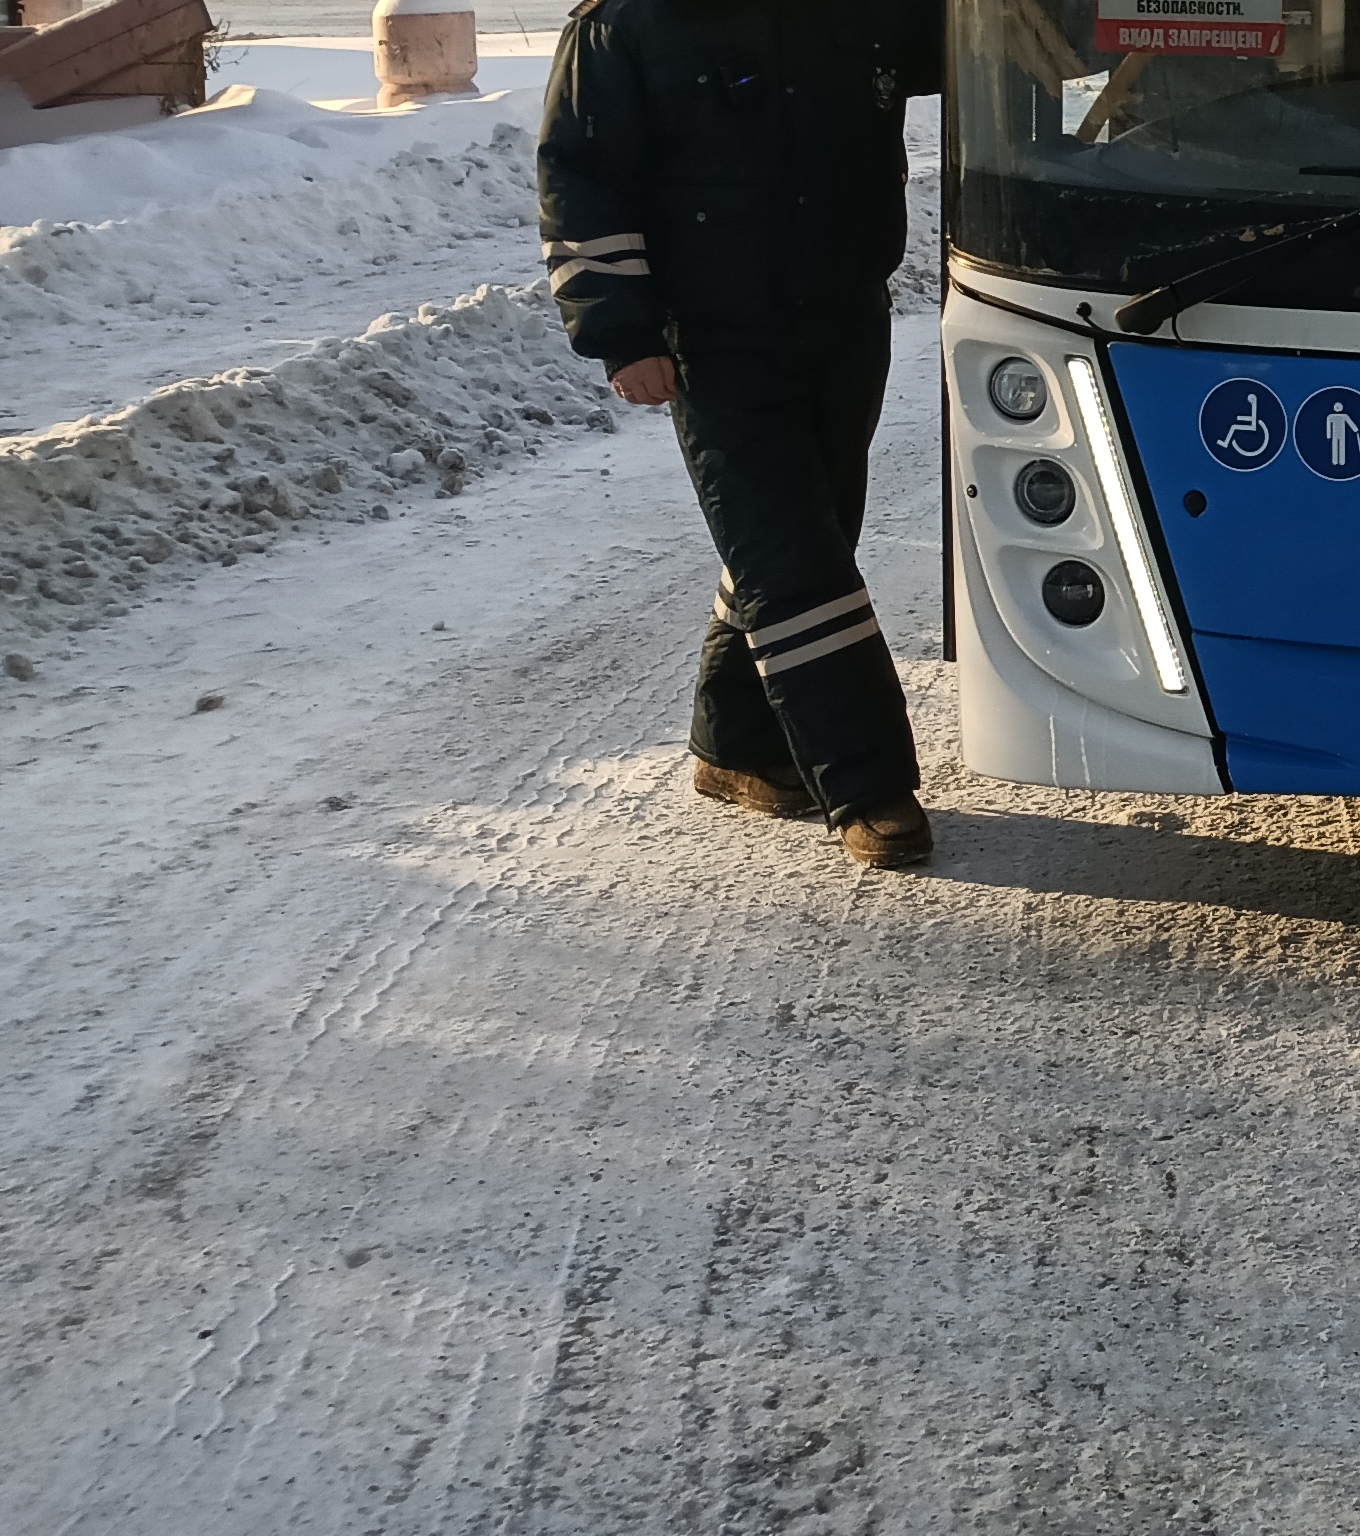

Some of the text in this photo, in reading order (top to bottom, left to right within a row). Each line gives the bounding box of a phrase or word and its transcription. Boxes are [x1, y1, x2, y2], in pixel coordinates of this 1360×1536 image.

[1136, 0, 1244, 16] БЕЗОПАСНОСТИ.
[1119, 27, 1263, 50] ВХОД ЗАПРЕЩЕН!
